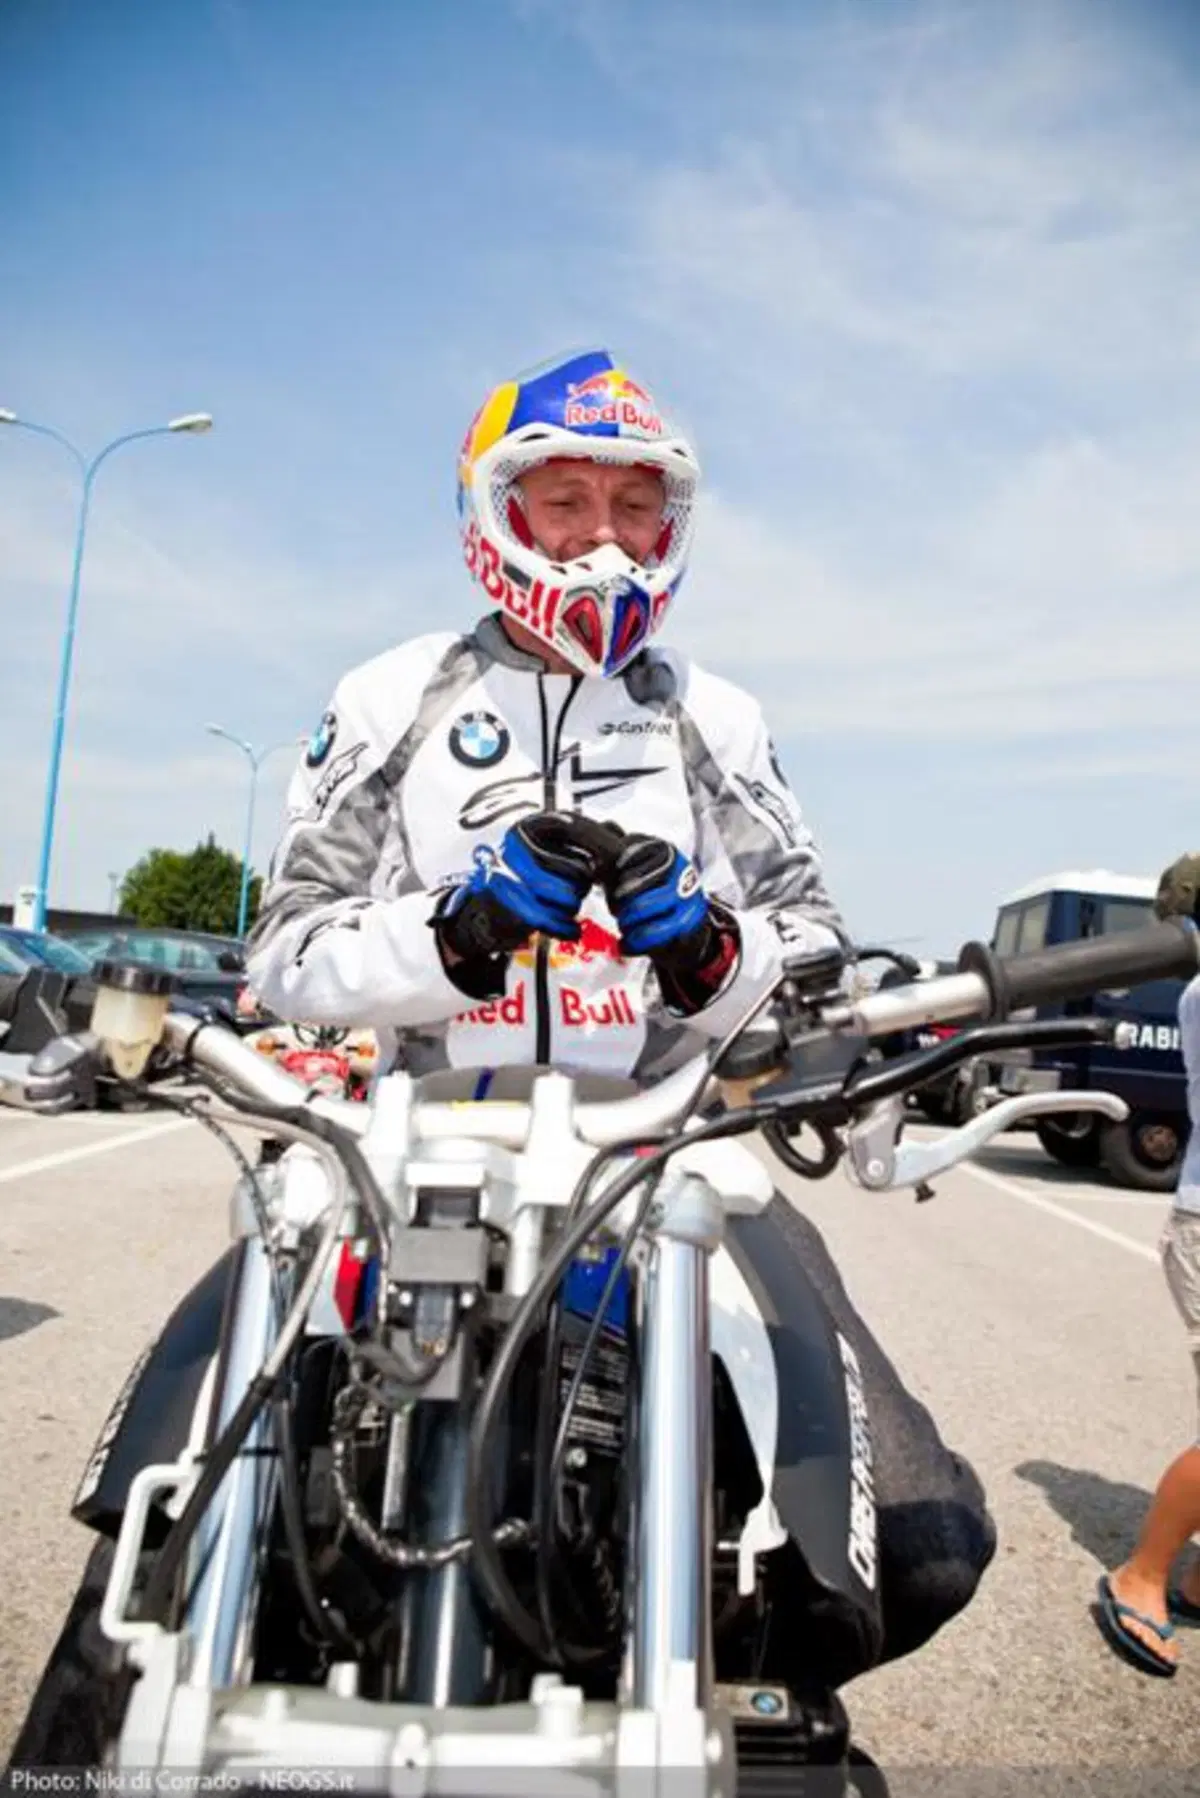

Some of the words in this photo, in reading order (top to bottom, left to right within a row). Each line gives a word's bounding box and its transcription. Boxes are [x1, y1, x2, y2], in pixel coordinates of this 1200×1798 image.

[565, 402, 617, 424] Red
[622, 402, 664, 434] Bull
[480, 537, 563, 640] Bull
[560, 987, 636, 1027] Bull
